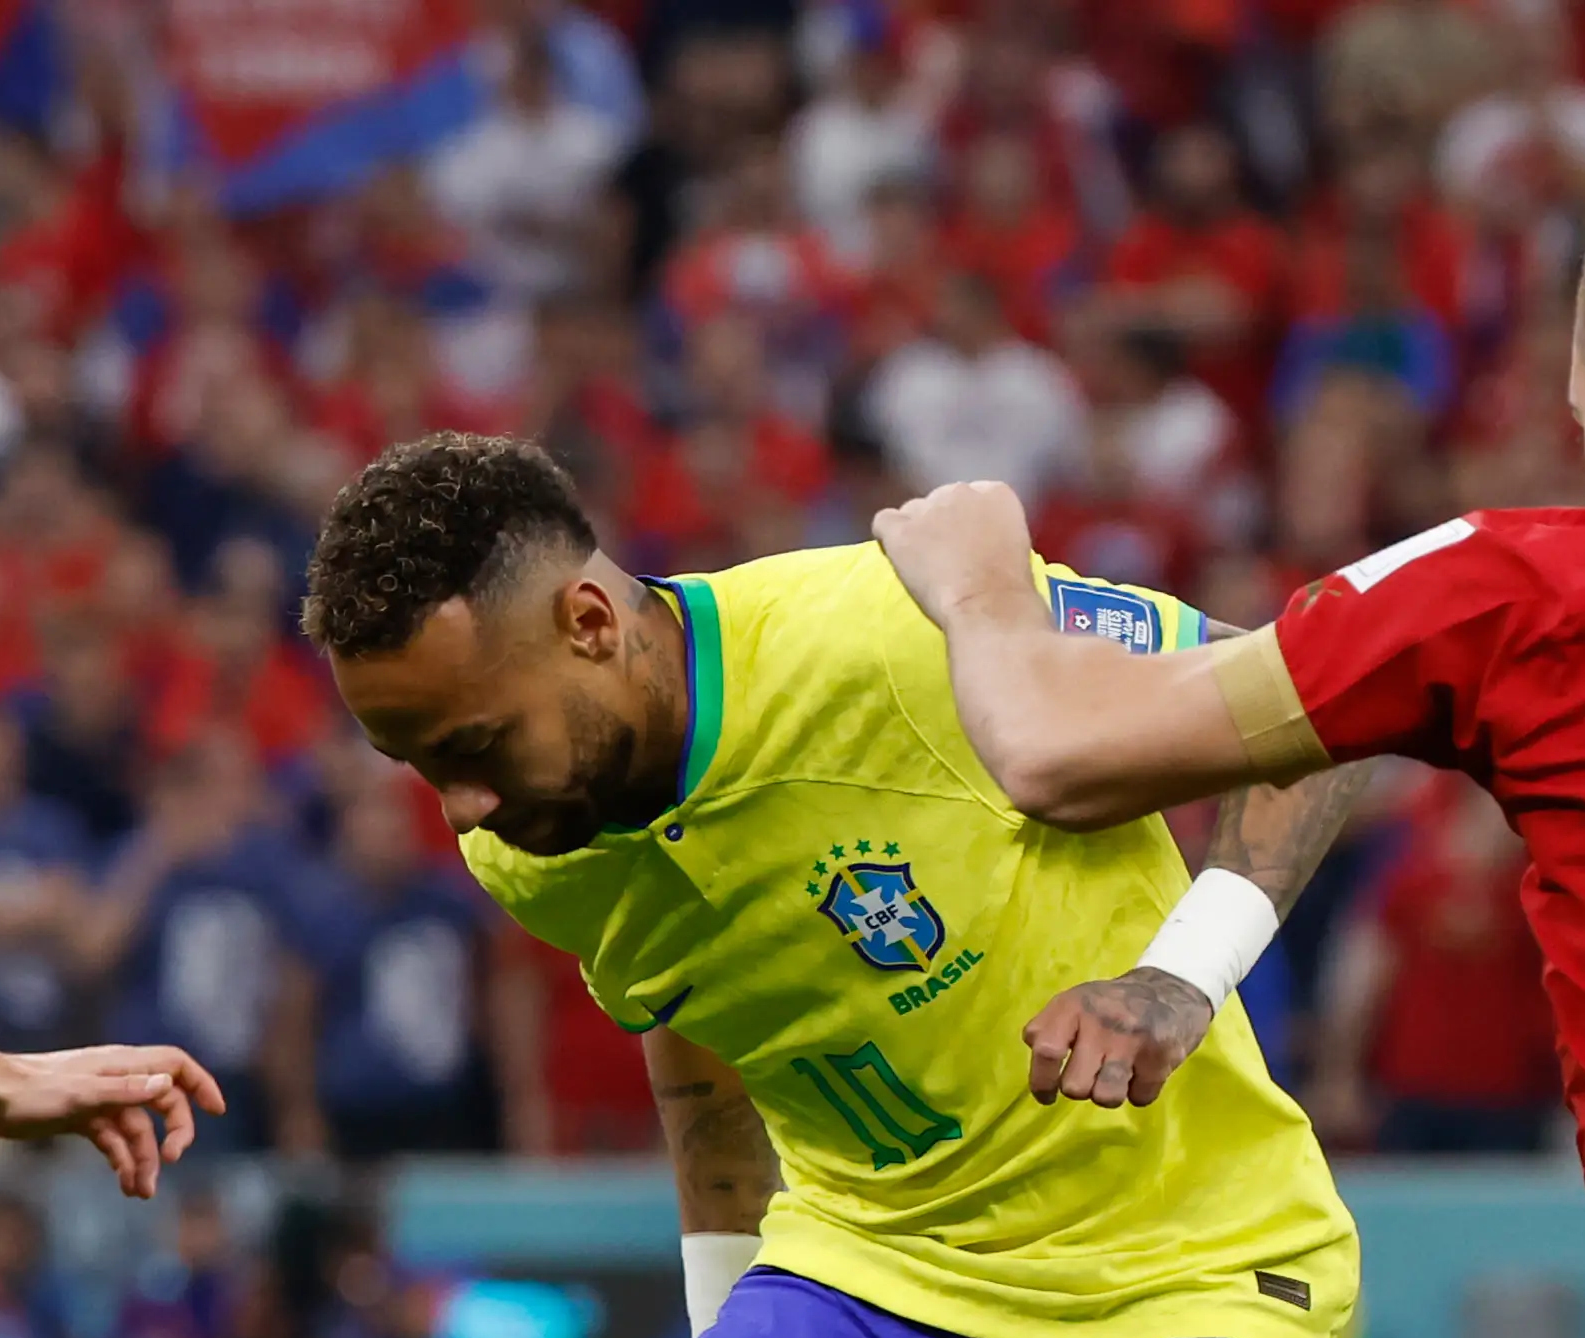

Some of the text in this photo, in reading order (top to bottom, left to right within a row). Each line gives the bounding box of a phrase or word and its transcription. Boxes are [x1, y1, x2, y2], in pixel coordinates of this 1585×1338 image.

[1106, 608, 1122, 640] NITES
[864, 904, 900, 931] CBF
[887, 948, 985, 1016] BRASIL
[790, 1040, 963, 1172] 10
